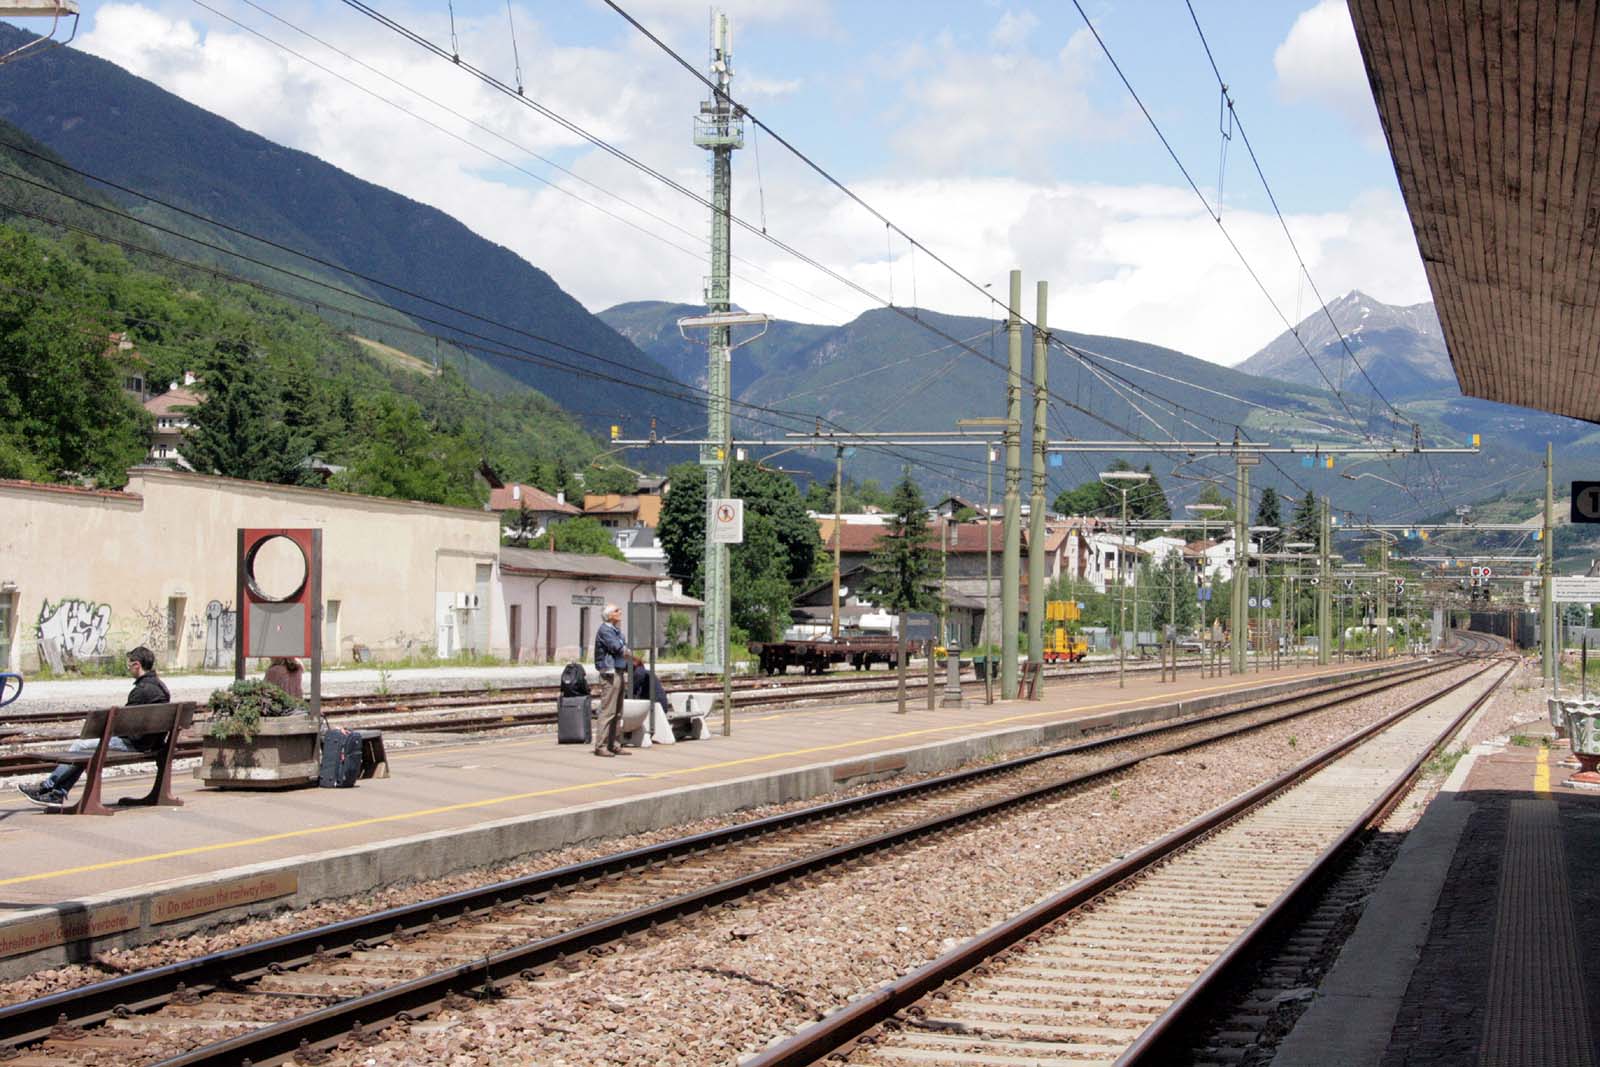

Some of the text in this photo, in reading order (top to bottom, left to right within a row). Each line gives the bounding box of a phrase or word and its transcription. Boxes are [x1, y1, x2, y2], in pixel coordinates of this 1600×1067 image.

[1589, 492, 1598, 512] 1
[181, 897, 194, 911] not
[196, 894, 215, 906] cross
[217, 887, 229, 903] the
[230, 884, 259, 900] railway
